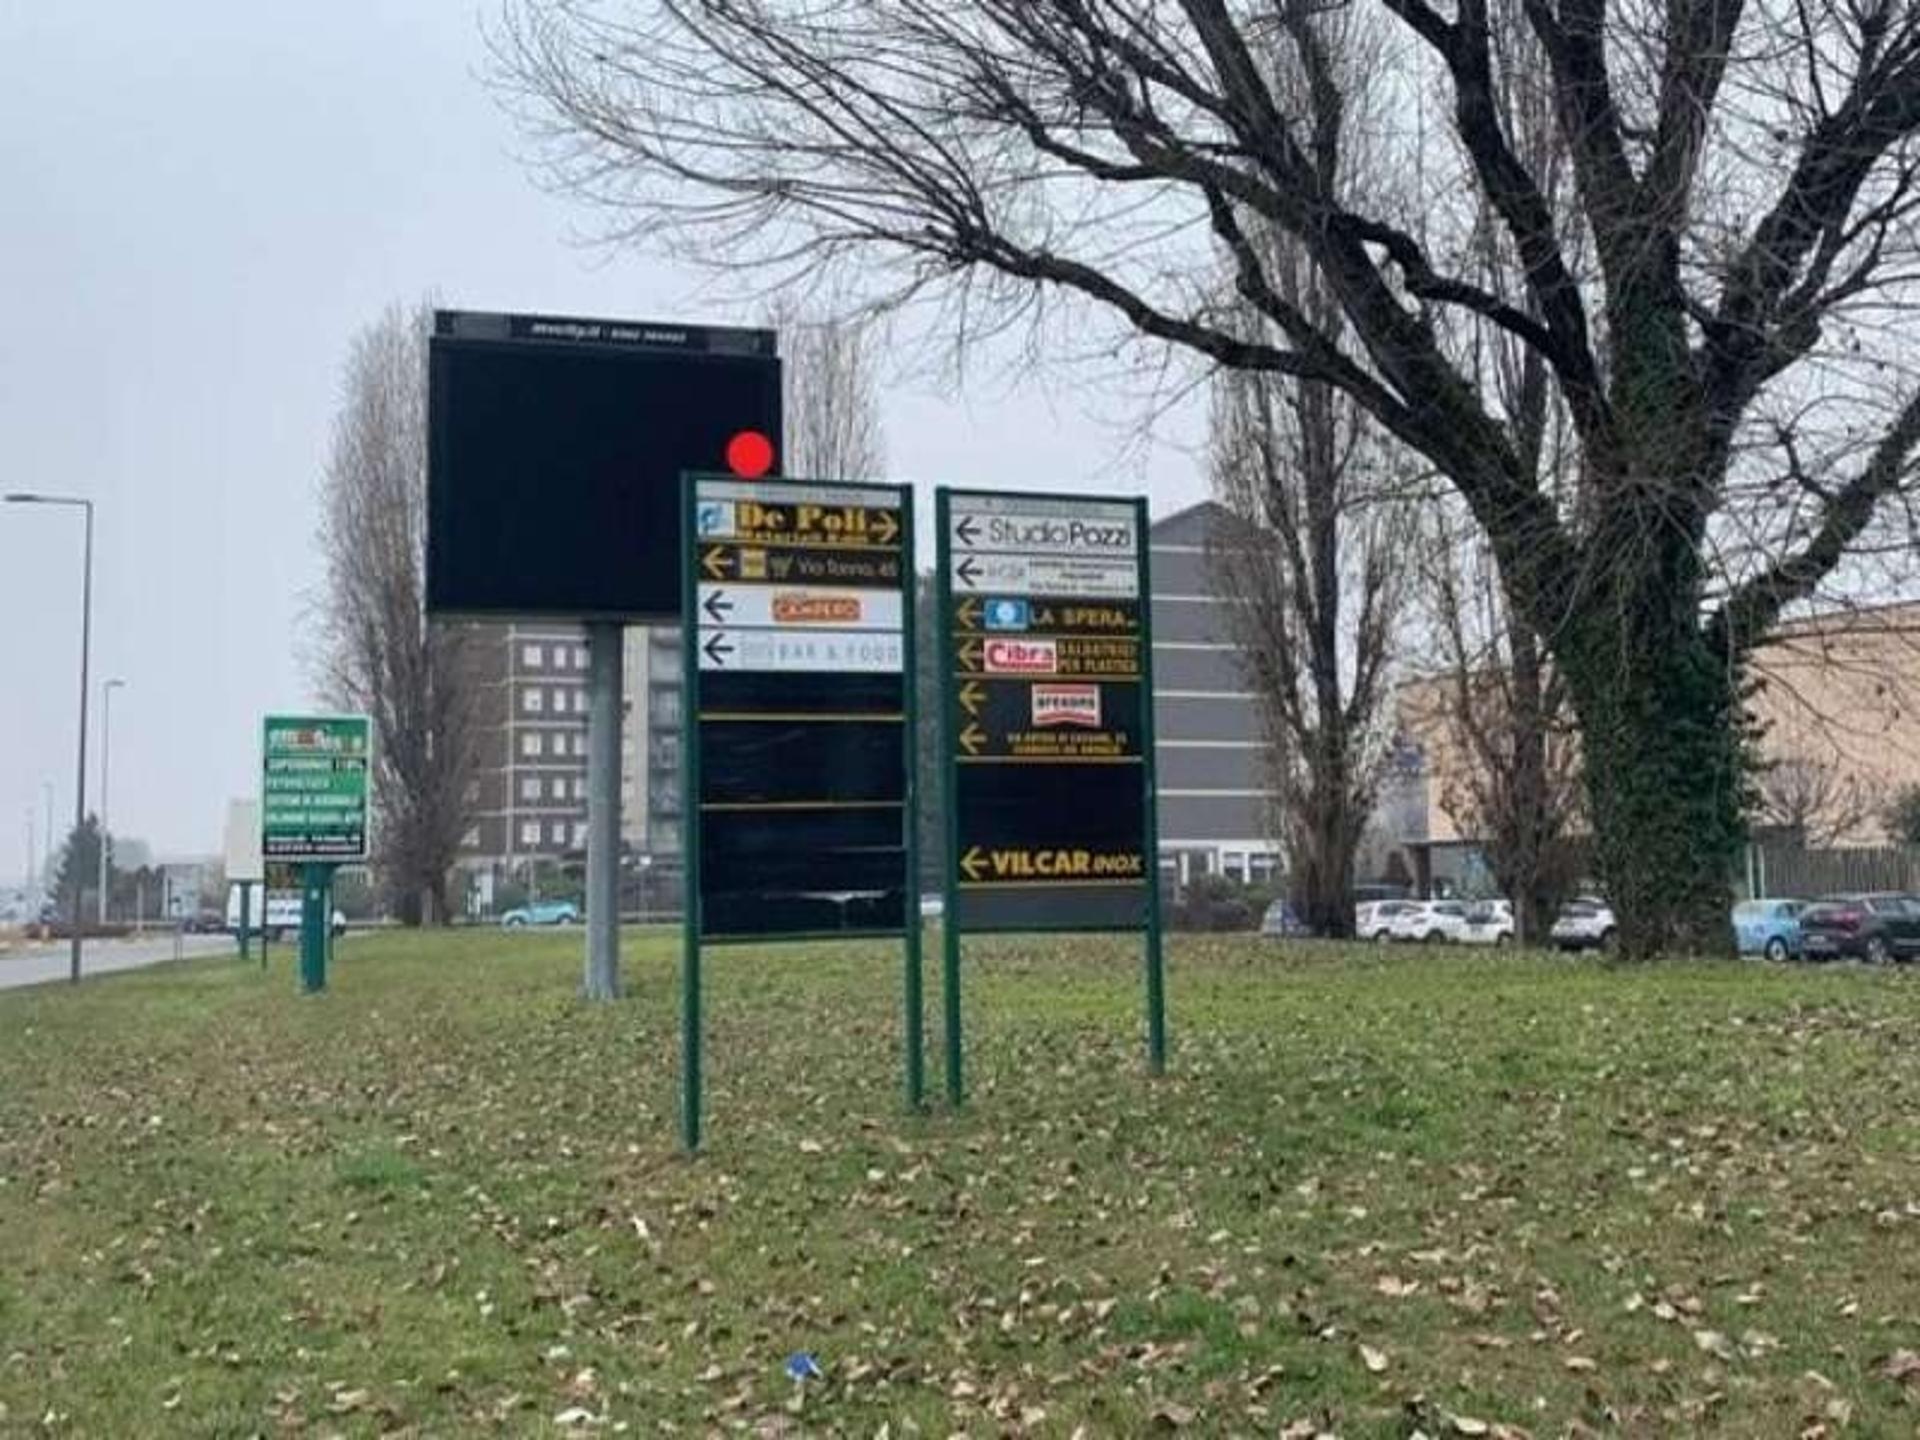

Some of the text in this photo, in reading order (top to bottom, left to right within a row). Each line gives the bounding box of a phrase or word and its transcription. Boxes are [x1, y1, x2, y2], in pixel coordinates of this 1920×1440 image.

[739, 501, 866, 532] De Poli
[1030, 608, 1054, 625] LA
[988, 643, 1055, 668] Cibra
[991, 851, 1142, 875] VILCAR INOX
